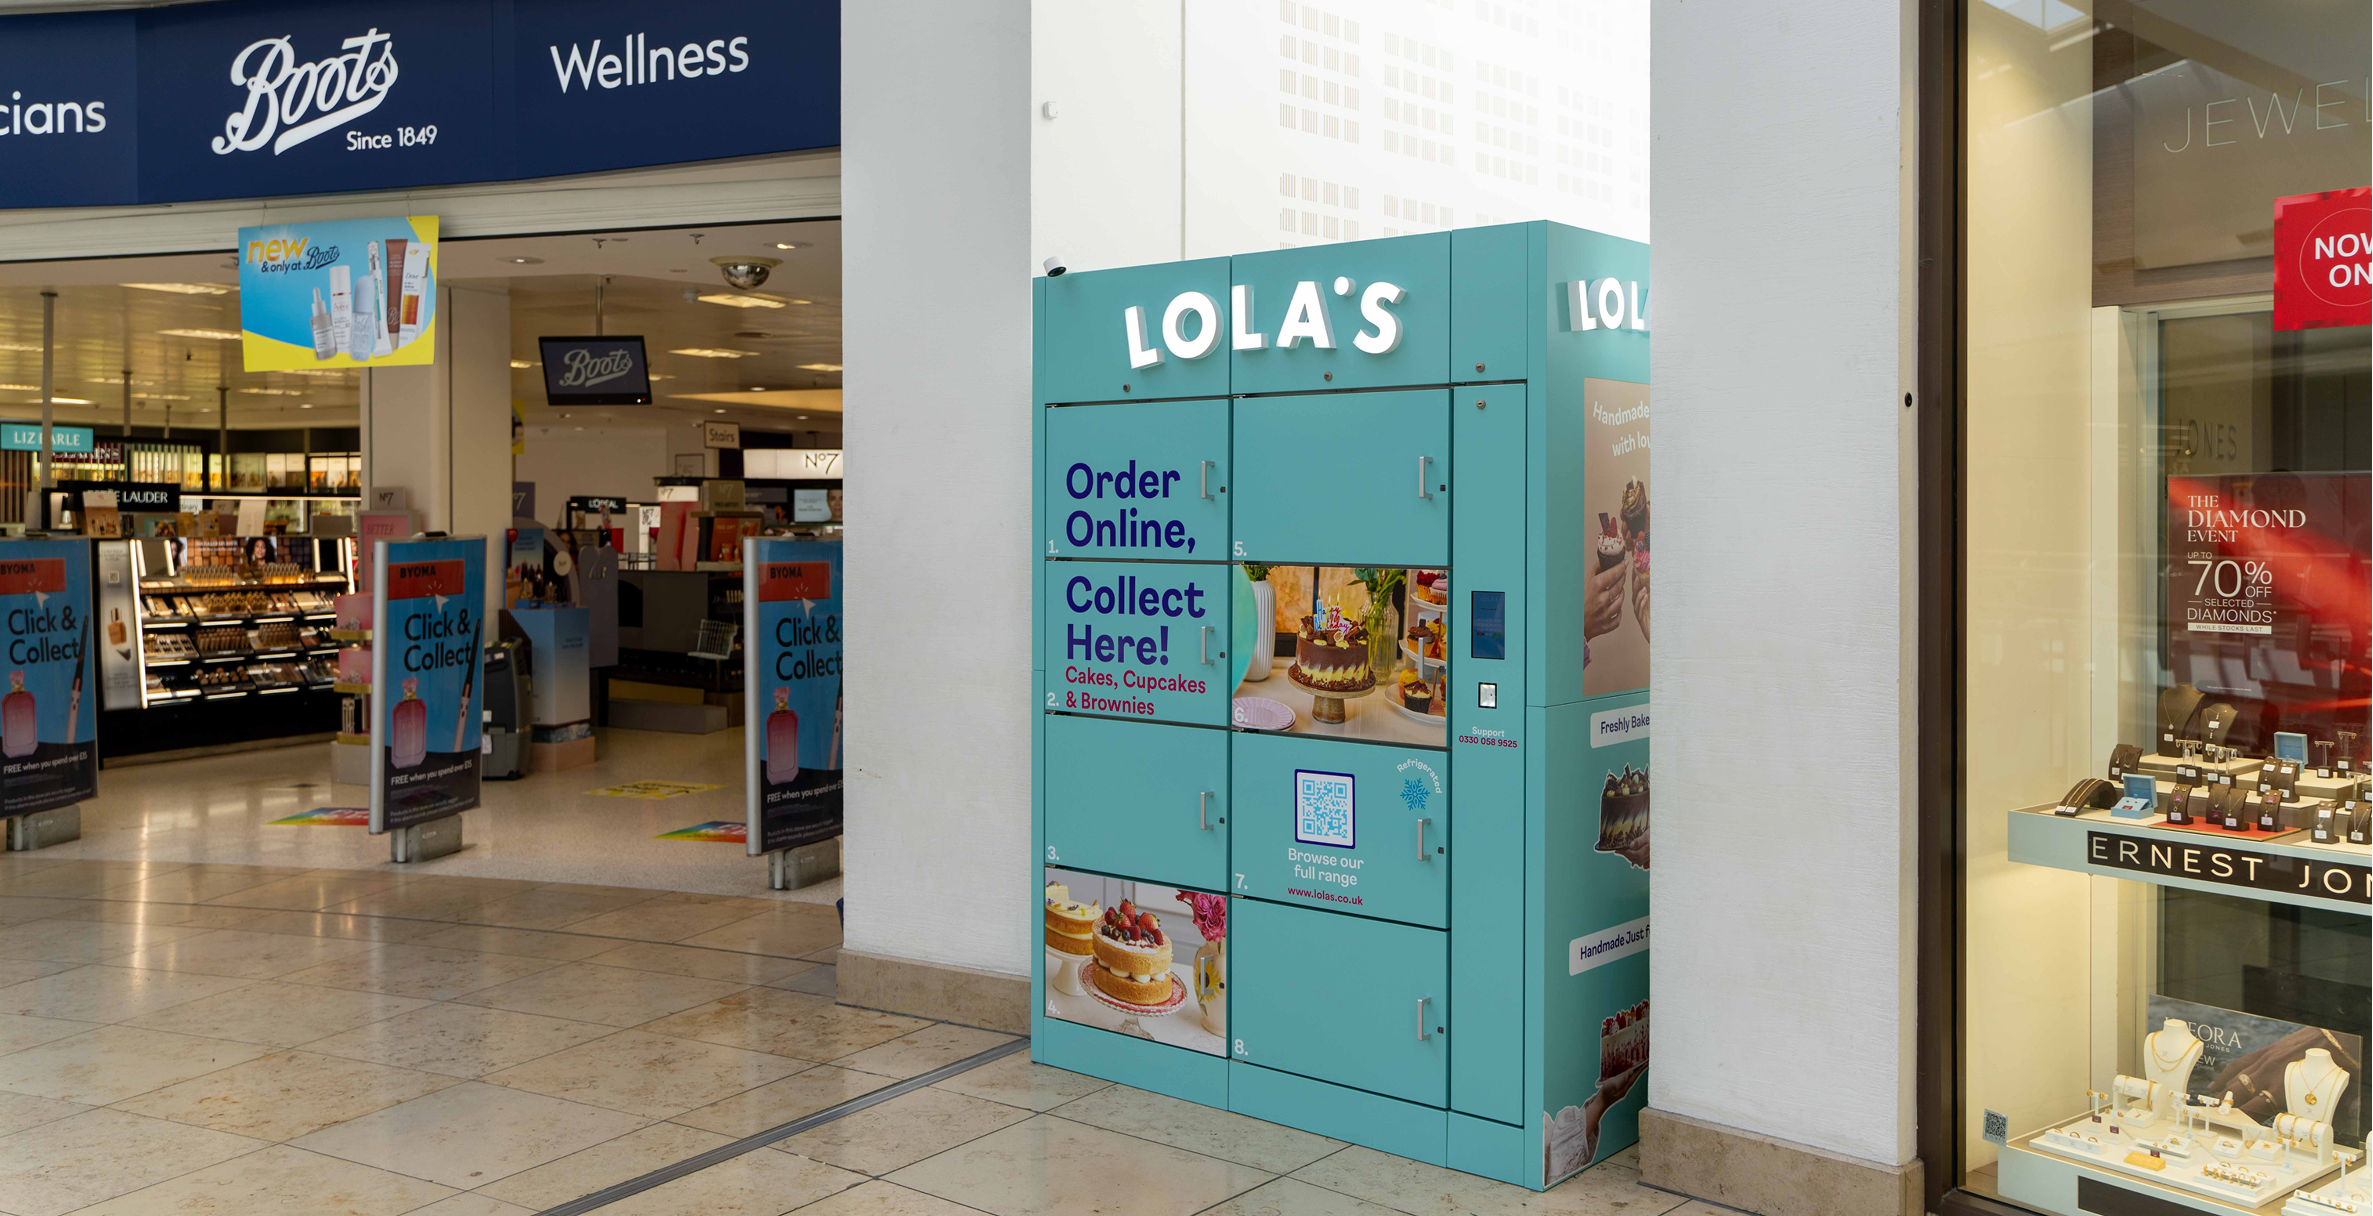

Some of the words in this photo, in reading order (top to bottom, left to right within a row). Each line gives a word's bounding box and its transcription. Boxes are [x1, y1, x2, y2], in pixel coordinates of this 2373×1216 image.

[550, 32, 749, 94] Wellness
[212, 27, 399, 156] Boots
[346, 130, 392, 151] Since
[398, 125, 438, 147] 1849
[247, 237, 310, 264] new
[261, 261, 269, 273] &
[270, 261, 291, 275] only
[291, 260, 302, 272] at
[303, 246, 341, 270] Boots
[2329, 262, 2372, 288] ON
[1124, 276, 1408, 370] LOLA'S
[559, 348, 633, 387] Boots
[1593, 401, 1650, 426] Handmade
[14, 431, 36, 444] LIZ
[709, 428, 735, 443] Stairs
[1612, 433, 1636, 456] with
[1066, 460, 1181, 500] Order
[123, 491, 168, 503] LAUDER
[2188, 495, 2219, 508] THE
[2188, 509, 2306, 528] DIAMOND
[1066, 507, 1196, 554] Online,
[2188, 530, 2238, 543] EVENT
[1048, 540, 1060, 554] 1.
[1233, 541, 1248, 557] 5.
[2188, 551, 2199, 559] UP
[2201, 552, 2212, 560] TO
[0, 564, 36, 575] BYOMA
[400, 566, 436, 578] BYOMA
[770, 567, 803, 579] BYOMA
[2188, 560, 2272, 597] 70%
[1066, 576, 1206, 619] Collect
[2204, 598, 2254, 608] SELECTED
[2245, 586, 2272, 598] OFF
[8, 607, 58, 635] Click
[61, 605, 78, 631] &
[405, 611, 453, 641] Click
[457, 609, 471, 635] &
[776, 616, 822, 647] Click
[825, 614, 841, 643] &
[9, 637, 80, 665] Collect
[1067, 623, 1169, 666] Here!
[404, 642, 471, 672] Collect
[776, 649, 843, 681] Collect
[1065, 665, 1118, 689] Cakes,
[1123, 670, 1206, 694] Cupcakes
[1047, 692, 1060, 706] 2.
[1066, 691, 1077, 709] &
[1082, 692, 1155, 716] Brownies
[1234, 707, 1248, 723] 6.
[1601, 718, 1629, 734] Freshly
[1459, 735, 1479, 745] 0330
[1480, 737, 1496, 746] 058
[1498, 738, 1518, 748] 9525
[1472, 726, 1505, 737] Support
[3, 764, 22, 774] FREE
[23, 762, 40, 771] when
[41, 761, 51, 770] you
[52, 756, 68, 767] spend
[69, 755, 79, 763] over
[390, 775, 409, 786] FREE
[409, 773, 426, 783] when
[427, 771, 438, 781] you
[438, 766, 453, 777] spend
[454, 764, 464, 772] over
[1397, 758, 1443, 794] Refrigerated
[766, 792, 781, 803] FREE
[782, 790, 800, 799] when
[801, 789, 813, 799] you
[814, 783, 828, 796] spend
[1047, 846, 1060, 861] 3.
[1288, 847, 1337, 866] Browse
[1340, 857, 1364, 869] our
[1294, 865, 1315, 879] full
[1318, 869, 1358, 887] range
[2093, 836, 2264, 882] ERNEST
[2299, 865, 2372, 898] JO
[1235, 873, 1248, 890] 7.
[1287, 886, 1363, 906] www.lolas.co.uk
[1580, 933, 1625, 960] Handmade
[1626, 928, 1645, 945] Just
[1047, 999, 1060, 1015] 4.
[1234, 1038, 1248, 1056] 8.
